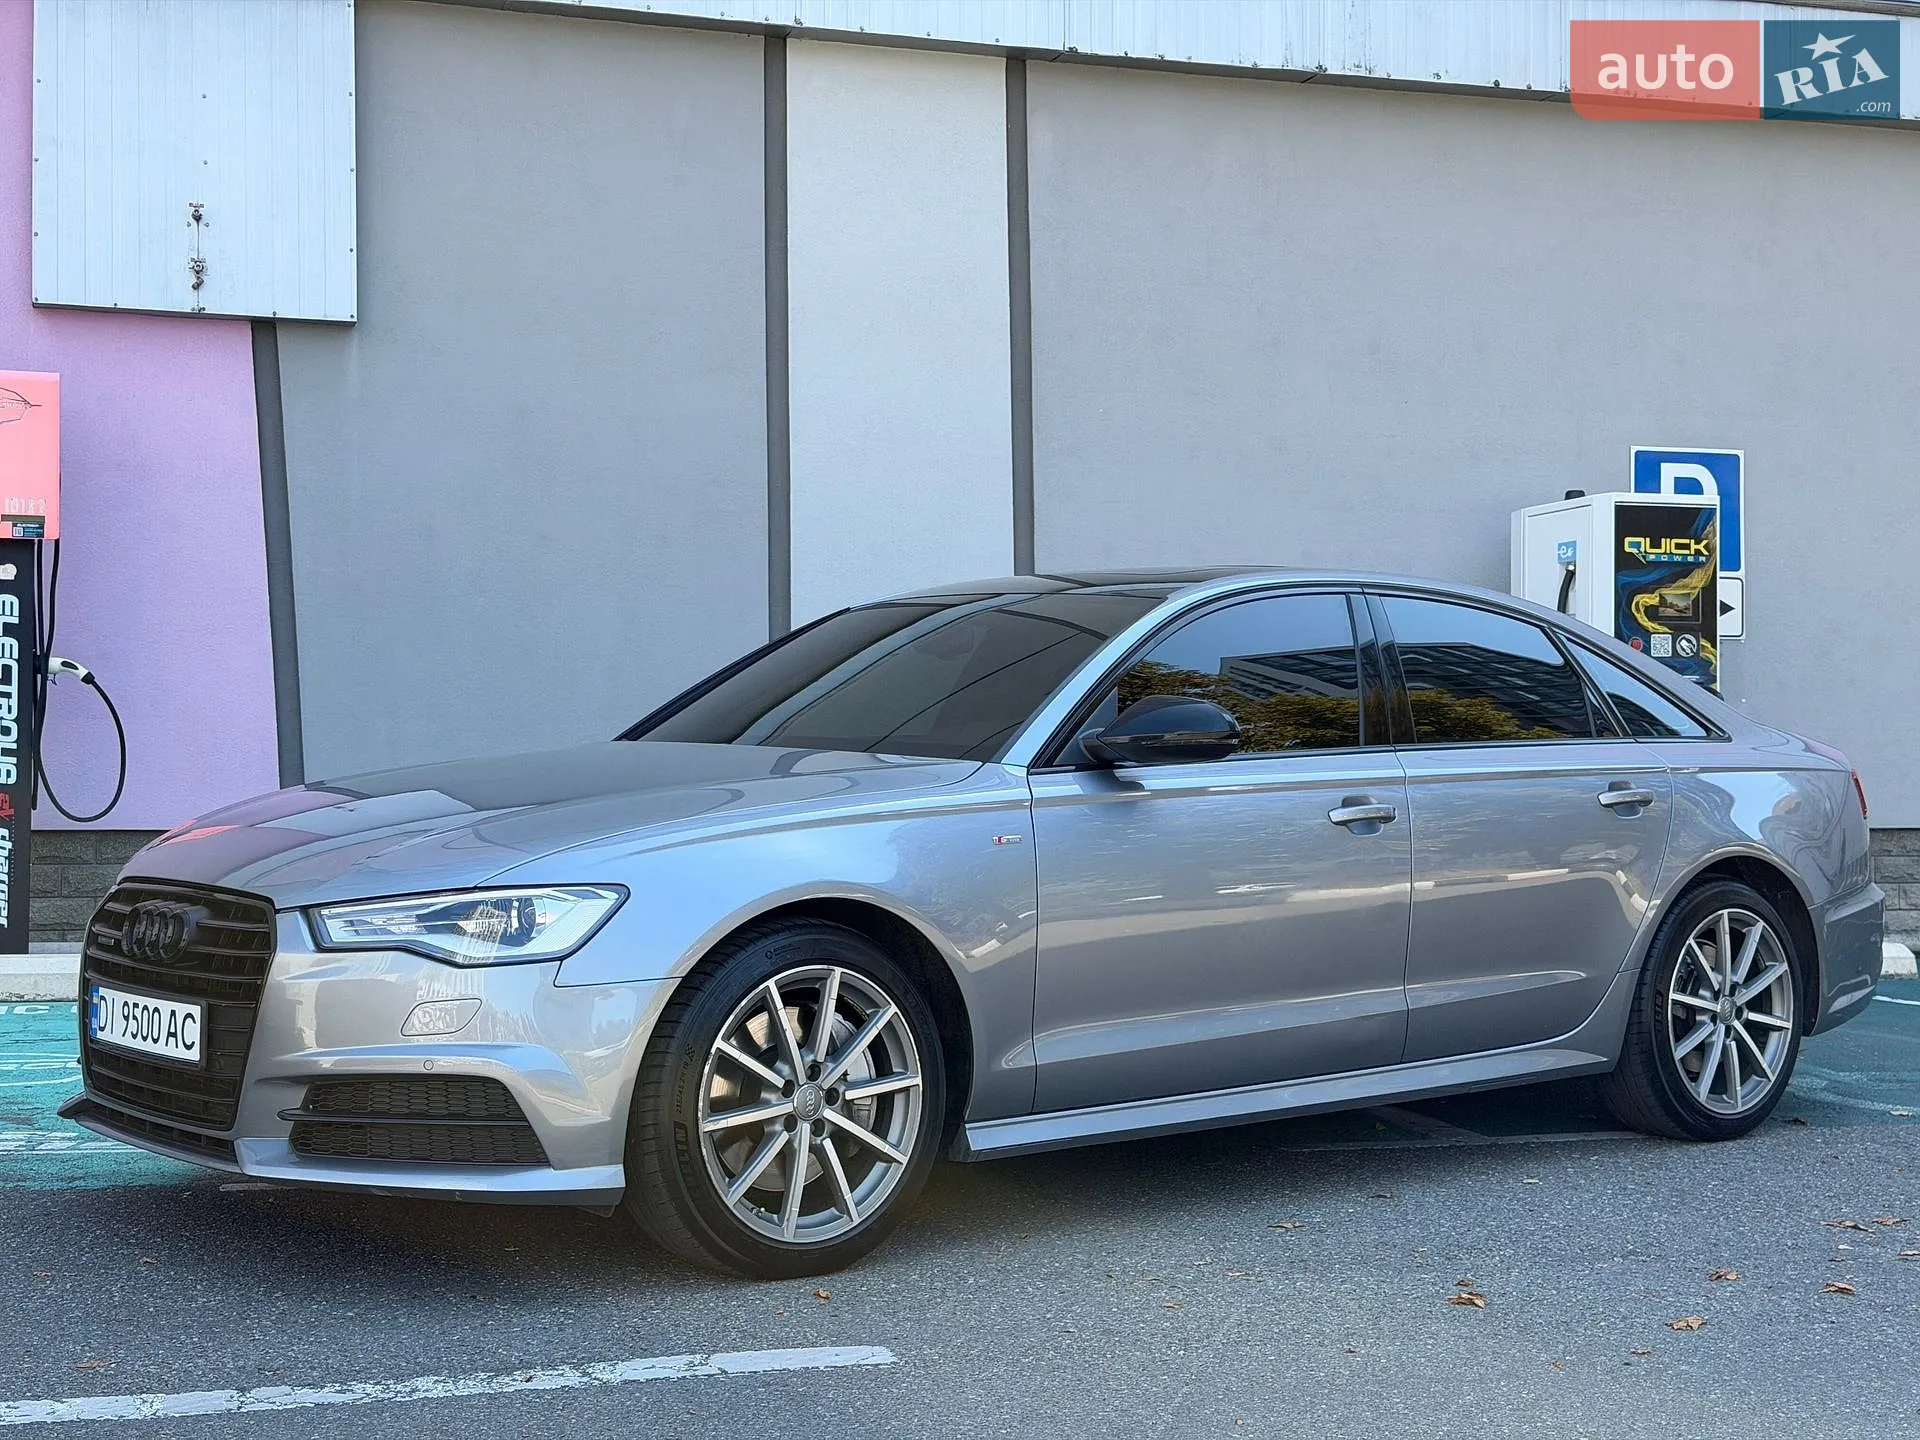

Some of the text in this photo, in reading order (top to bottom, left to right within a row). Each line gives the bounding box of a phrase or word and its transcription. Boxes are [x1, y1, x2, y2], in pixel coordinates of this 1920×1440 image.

[1623, 536, 1710, 557] QUICK
[1649, 554, 1707, 563] POWER
[98, 994, 197, 1051] DI 9500 AC
